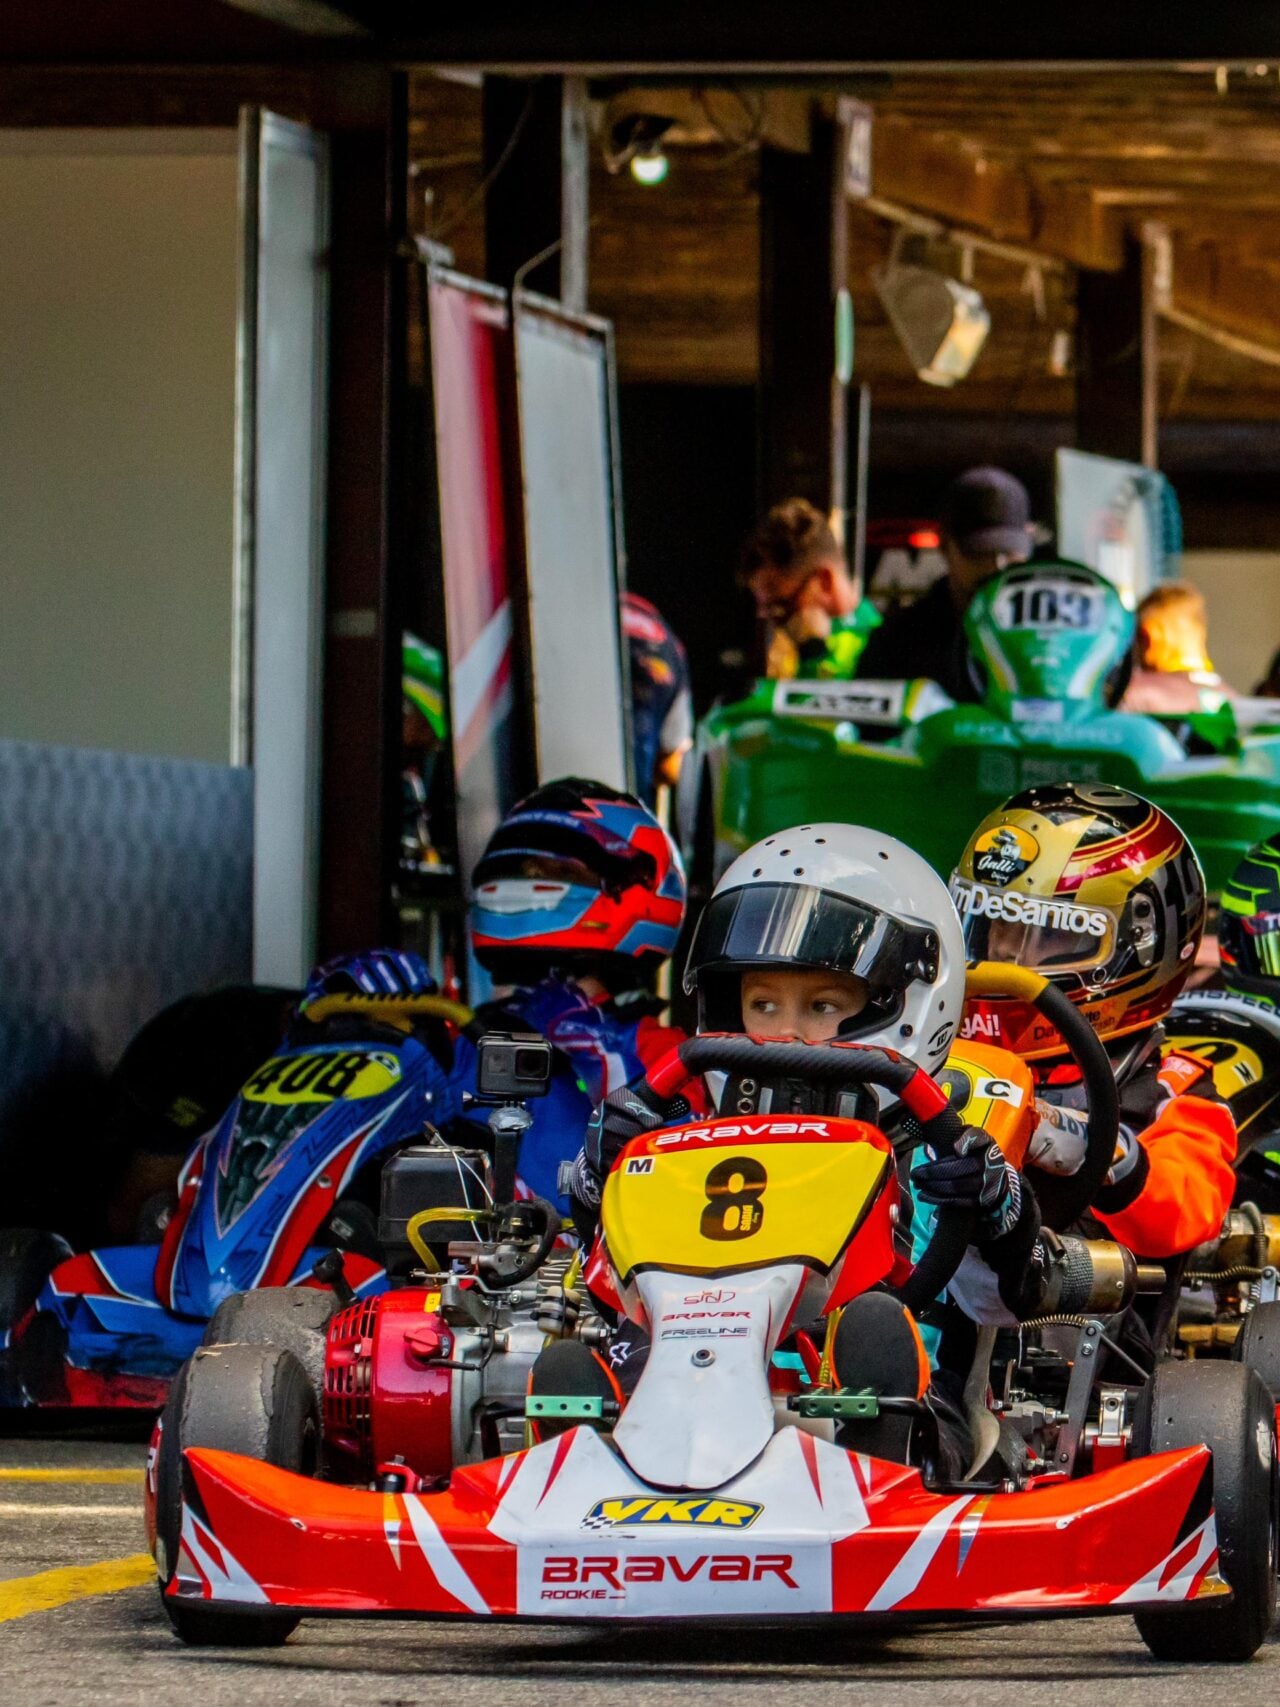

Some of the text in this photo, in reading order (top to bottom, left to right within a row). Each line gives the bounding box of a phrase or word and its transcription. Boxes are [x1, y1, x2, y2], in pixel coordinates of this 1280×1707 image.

[251, 1052, 371, 1098] 408
[627, 1158, 652, 1173] M
[700, 1156, 768, 1242] 8
[661, 1327, 749, 1338] FREELINE
[541, 1589, 607, 1600] ROOKIE
